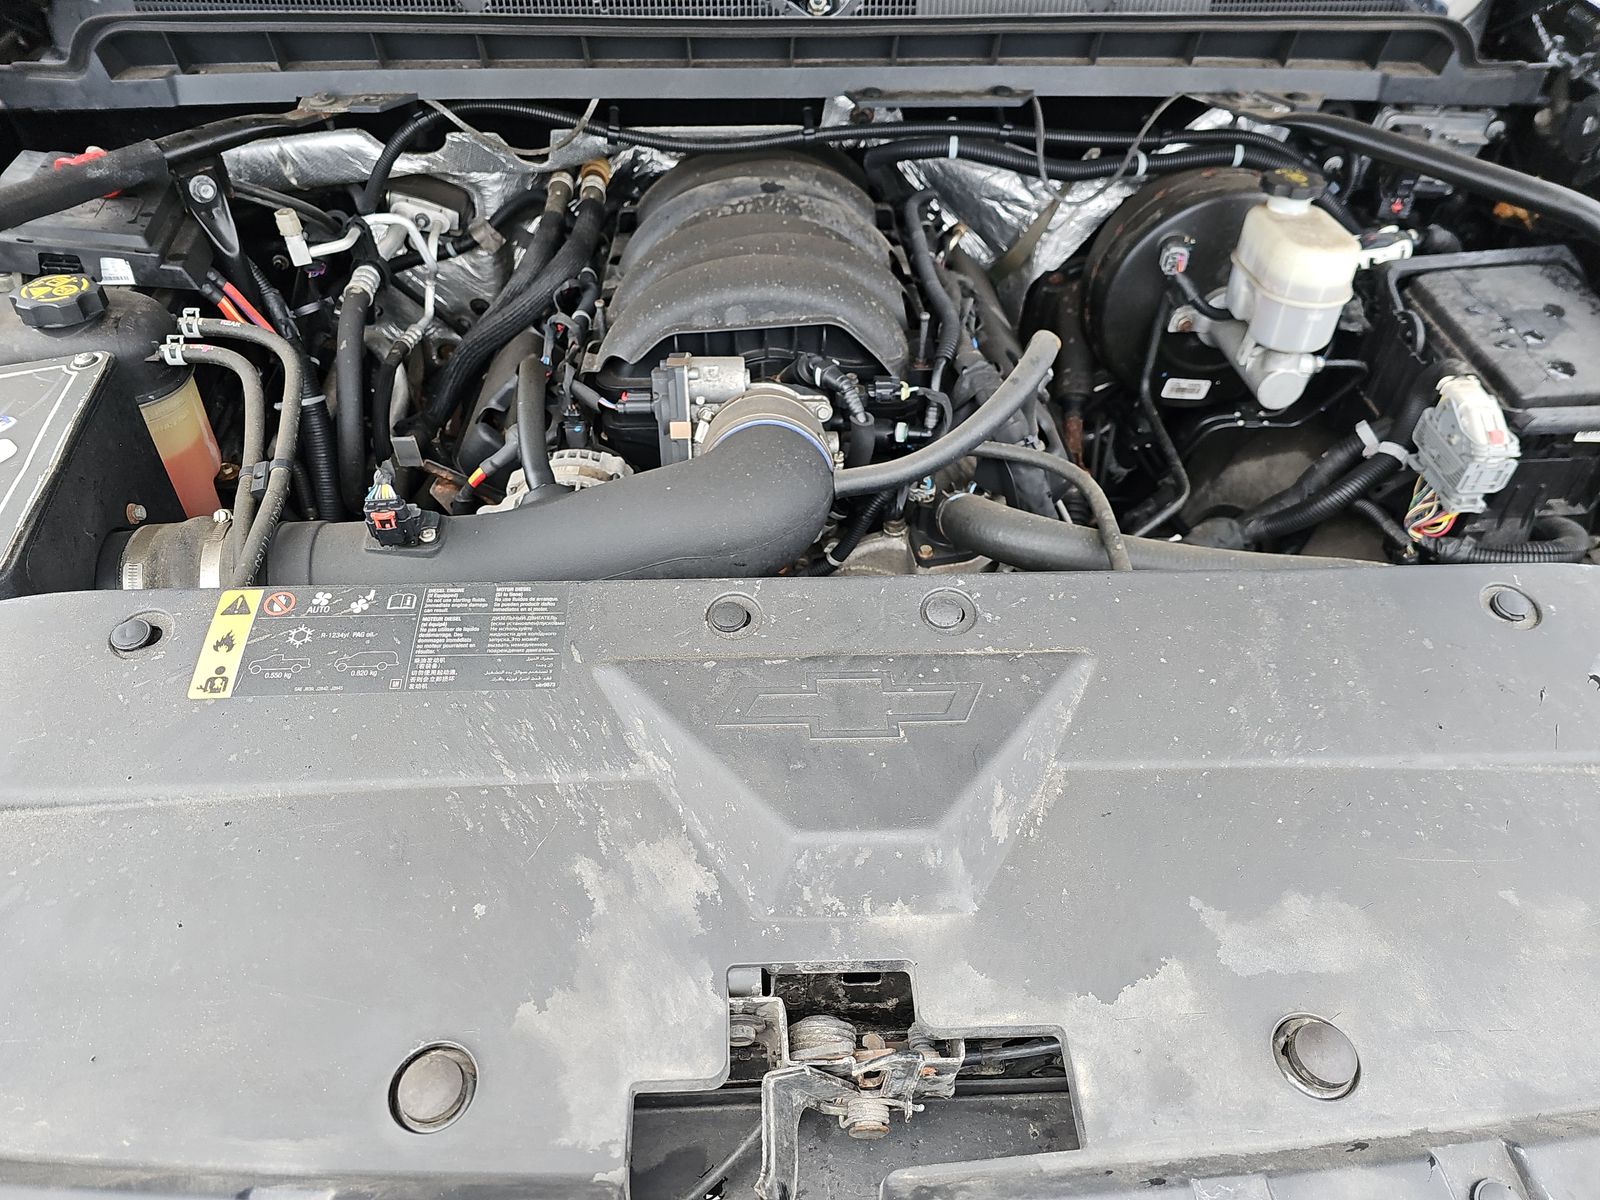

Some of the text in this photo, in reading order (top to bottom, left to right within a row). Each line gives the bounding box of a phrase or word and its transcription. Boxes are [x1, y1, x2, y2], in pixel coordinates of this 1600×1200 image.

[306, 605, 331, 614] AUTO
[264, 671, 292, 679] 0.550 kg
